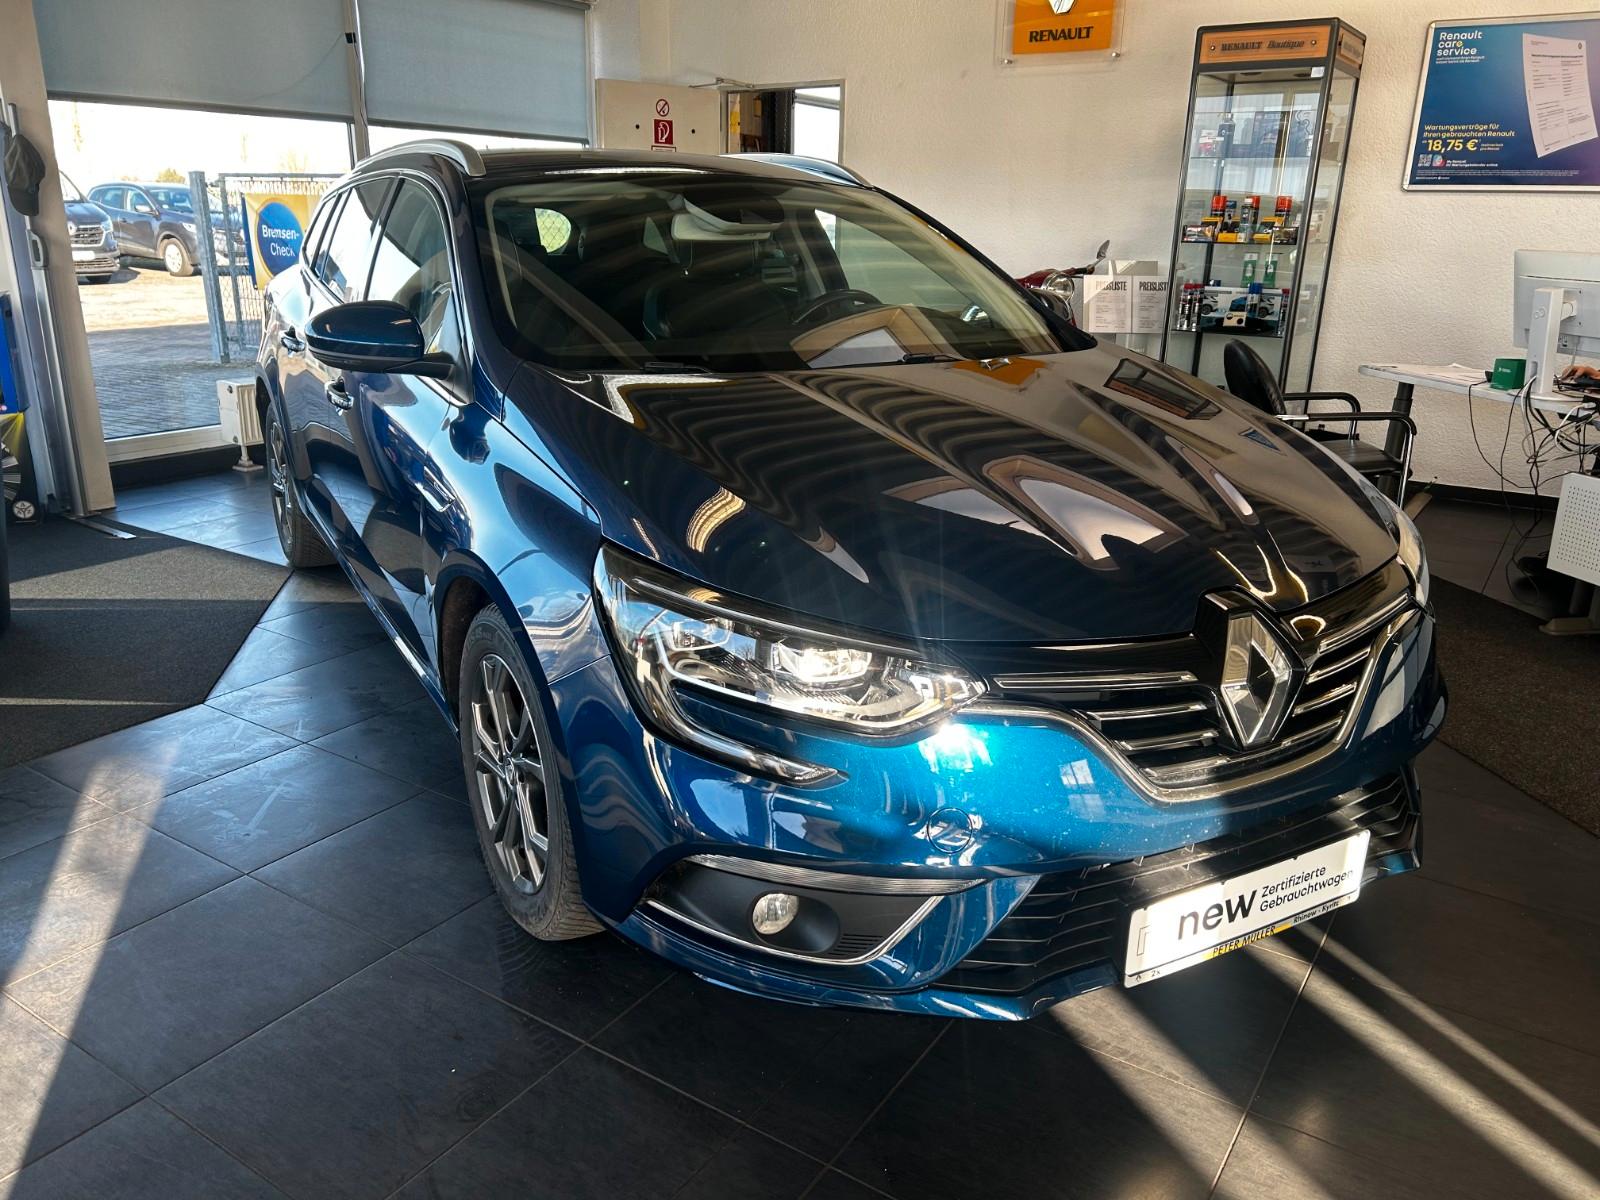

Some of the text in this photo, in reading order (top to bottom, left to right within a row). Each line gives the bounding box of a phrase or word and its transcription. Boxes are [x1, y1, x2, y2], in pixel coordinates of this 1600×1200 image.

[1029, 26, 1094, 42] RENAULT
[1439, 30, 1483, 40] Renault
[1220, 41, 1263, 51] RENAULT
[1438, 40, 1463, 48] care
[1436, 47, 1477, 56] service
[1427, 139, 1463, 153] 18,75
[1466, 139, 1479, 151] €
[262, 225, 300, 239] Bremsen-
[270, 243, 296, 257] Check
[1139, 281, 1168, 291] PREISLIST
[1261, 866, 1326, 898] Zertifizierte
[1177, 890, 1257, 940] new
[1212, 939, 1241, 957] PETER
